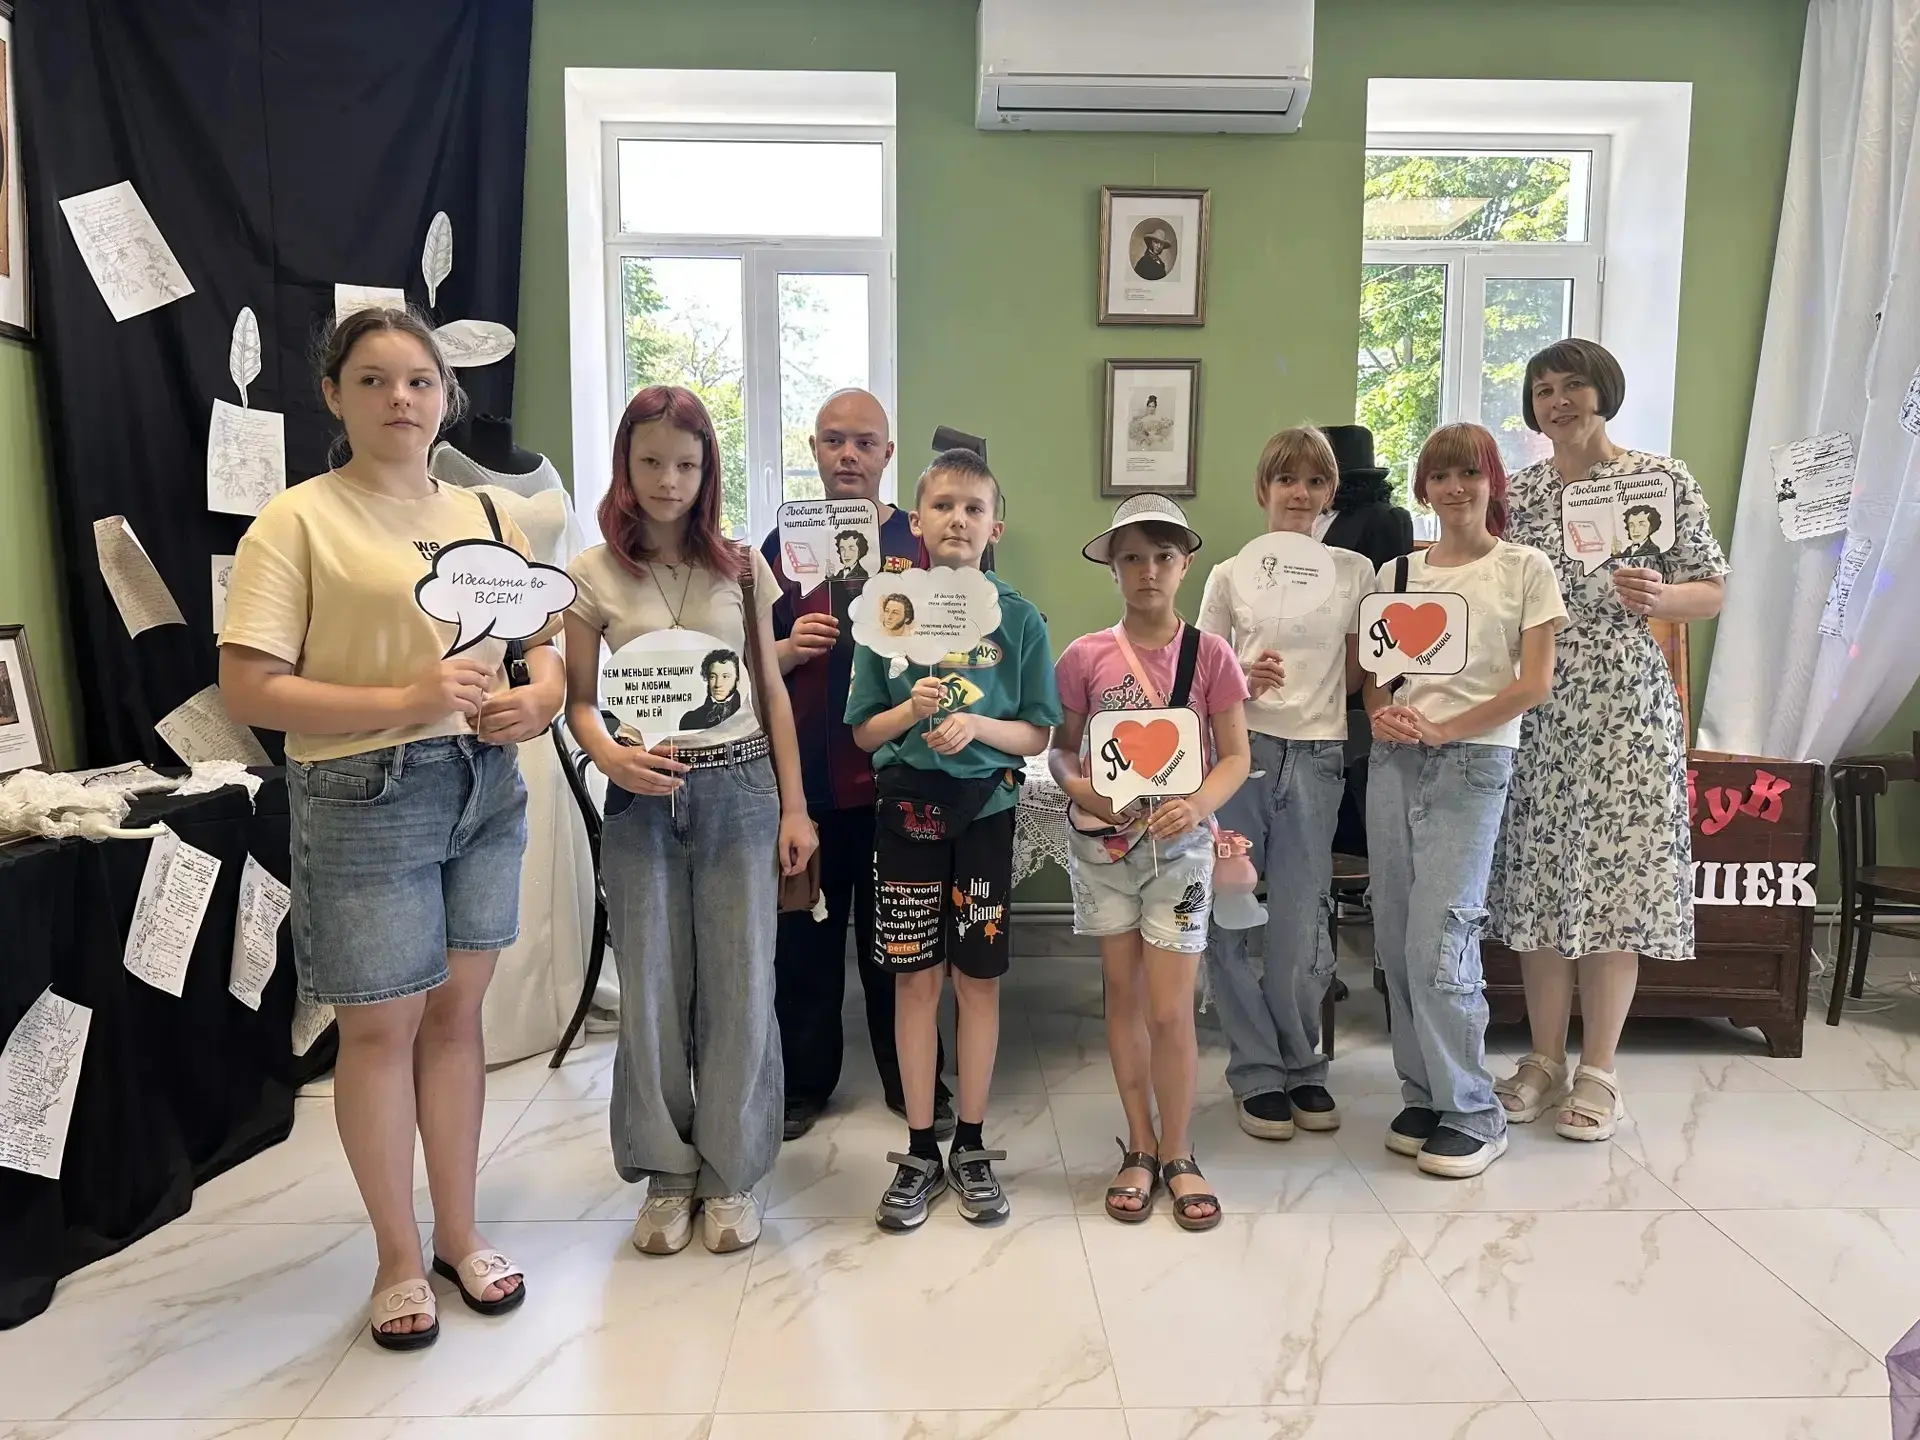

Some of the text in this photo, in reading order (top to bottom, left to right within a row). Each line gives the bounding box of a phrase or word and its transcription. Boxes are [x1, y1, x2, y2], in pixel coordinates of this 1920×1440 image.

[1570, 478, 1663, 496] Любите Пушкина,
[1568, 487, 1668, 508] читайте Пушкина!
[785, 504, 869, 517] Любите Пушкина,
[784, 515, 873, 529] читайте Пушкина!
[452, 572, 548, 589] Идеальна во
[474, 591, 523, 605] ВСЕМ!
[1369, 618, 1452, 666] Я Пушкина
[602, 666, 694, 678] ЧЕМ МЕНЬШЕ ЖЕНЩИНУ
[625, 682, 639, 691] МЫ
[607, 693, 692, 706] ТЕМ ЛЕГЧЕ НРАВИМСЯ
[636, 706, 663, 718] МЫ ЕЙ
[1100, 738, 1186, 787] Я Пушкина
[880, 885, 939, 894] see the world
[970, 878, 990, 899] big
[882, 896, 891, 905] in
[899, 896, 938, 906] different
[909, 908, 930, 919] light
[970, 903, 1003, 922] Game
[917, 916, 939, 928] living
[884, 932, 896, 941] my
[897, 931, 926, 941] dream
[888, 942, 920, 953] perfect
[891, 950, 933, 964] observing
